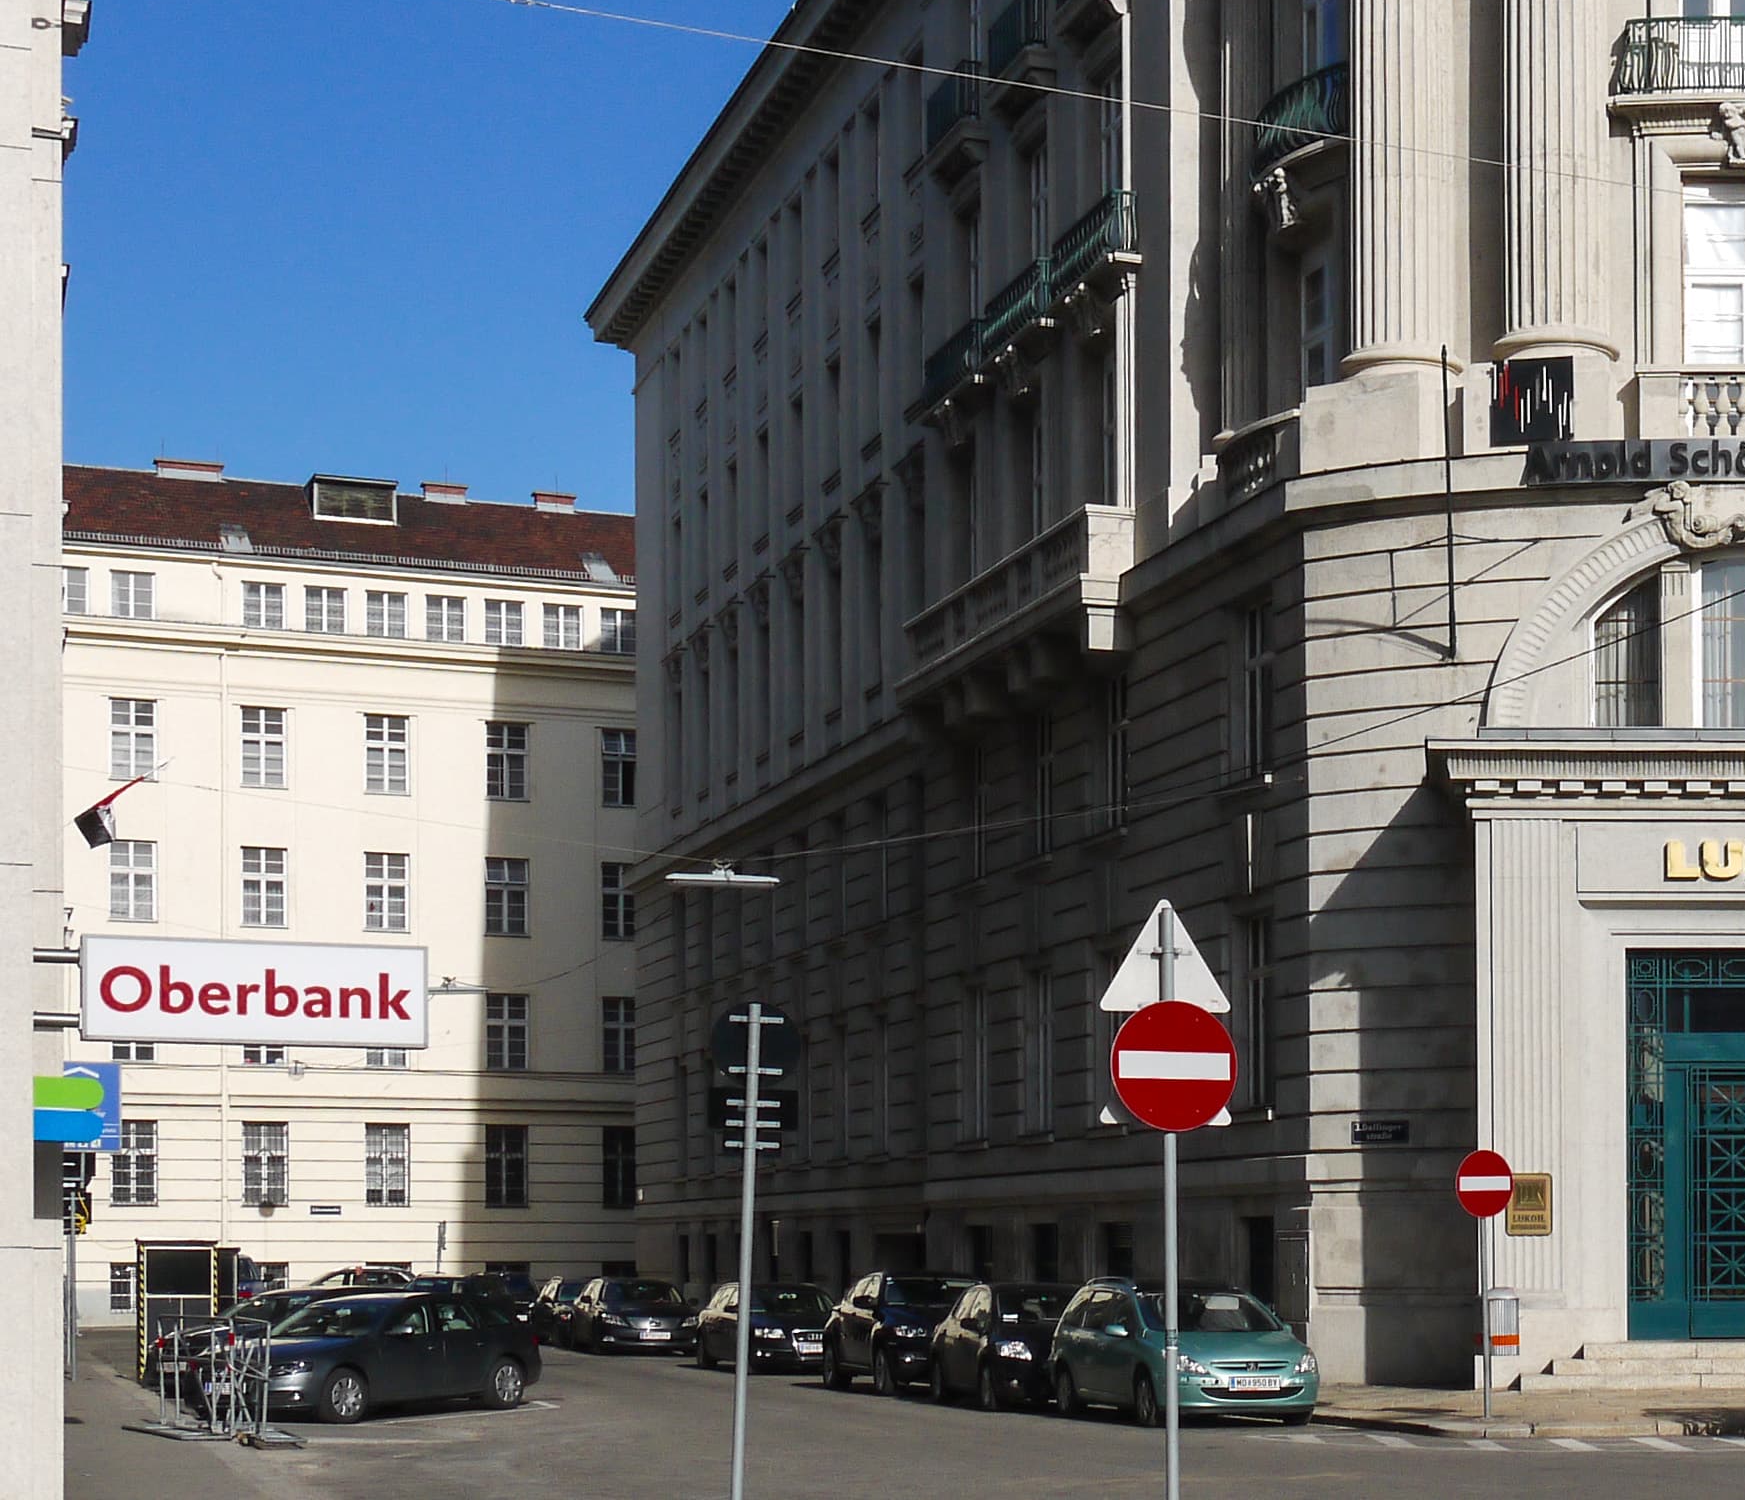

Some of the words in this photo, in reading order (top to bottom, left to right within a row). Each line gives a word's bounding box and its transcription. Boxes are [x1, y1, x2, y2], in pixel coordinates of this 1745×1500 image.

[1526, 444, 1652, 481] Arnold
[99, 964, 412, 1021] Oberbank
[1512, 1213, 1546, 1223] LUKOIL
